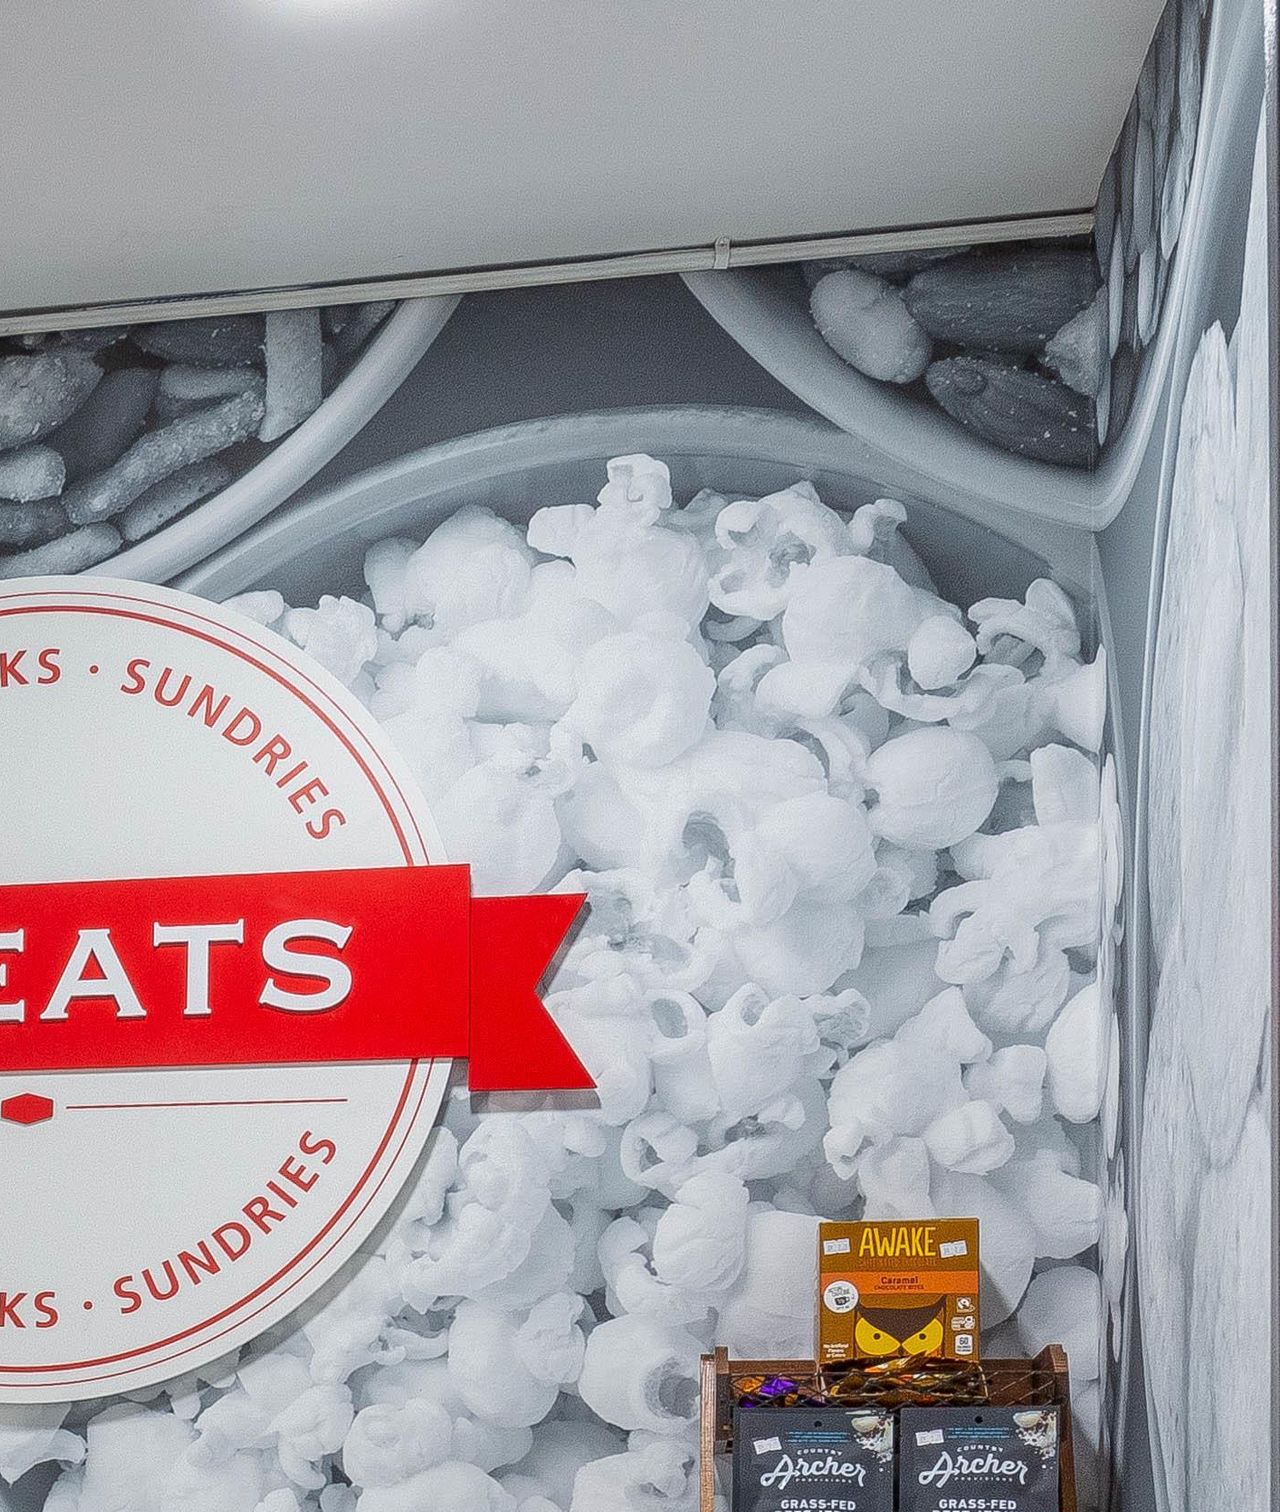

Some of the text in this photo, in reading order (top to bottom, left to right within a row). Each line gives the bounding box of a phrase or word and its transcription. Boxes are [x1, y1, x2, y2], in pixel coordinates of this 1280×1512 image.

[121, 658, 346, 843] SUNDRIES
[113, 1131, 337, 1313] SUNDRIES
[859, 1227, 936, 1257] AWAKE
[881, 1276, 919, 1285] Caramel
[797, 1448, 843, 1456] COUNTRY
[956, 1444, 1004, 1453] COUNTRY
[760, 1454, 866, 1490] Archer
[918, 1451, 1028, 1488] Archer
[781, 1499, 856, 1511] GRASS-FED
[939, 1499, 1017, 1510] GRASS-FED
